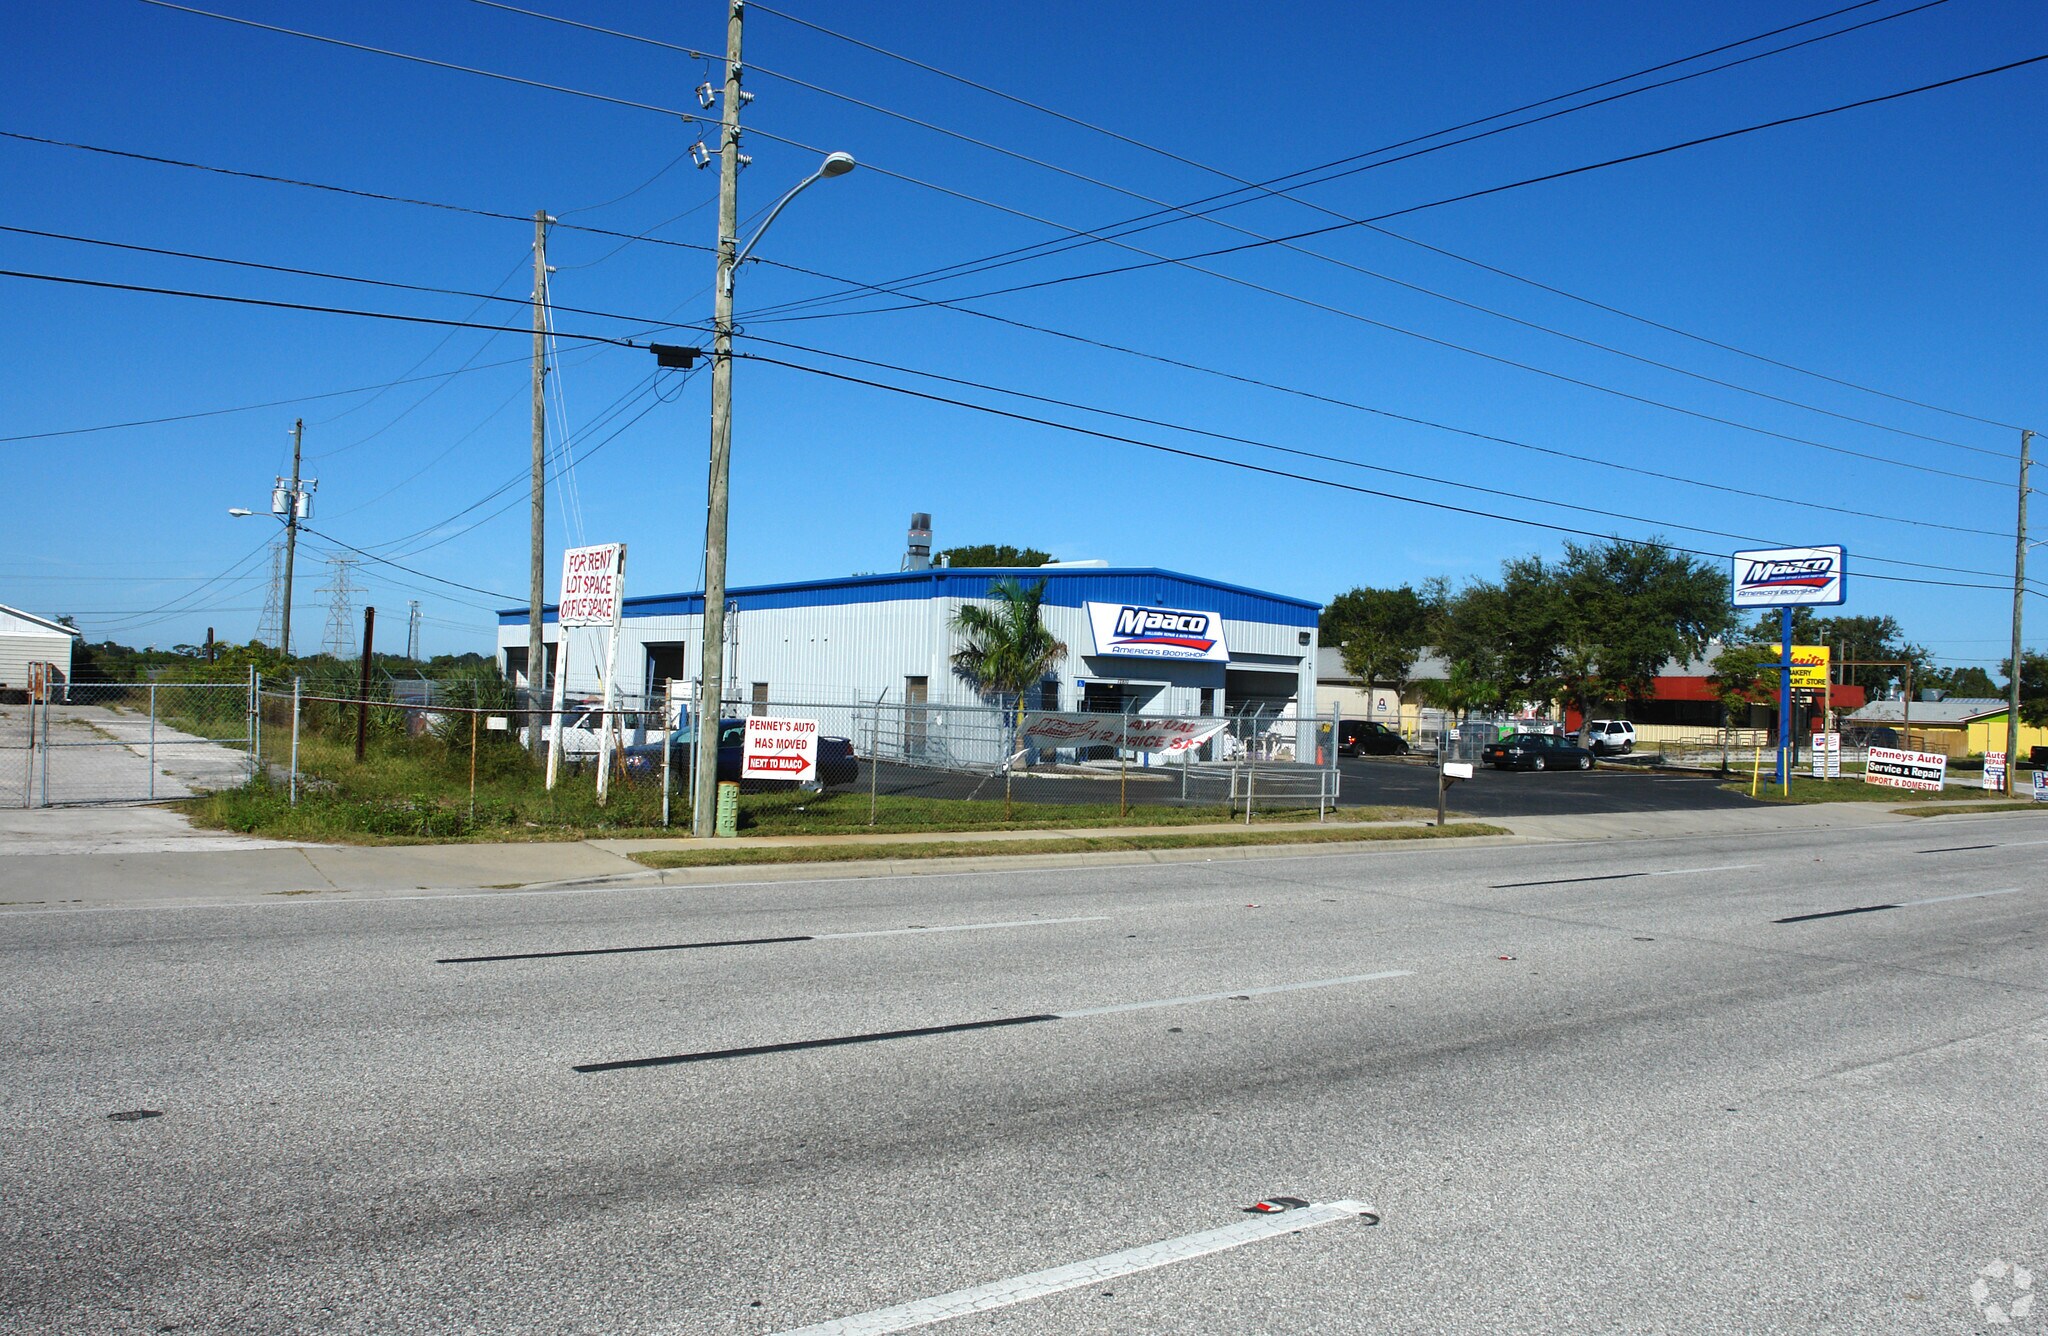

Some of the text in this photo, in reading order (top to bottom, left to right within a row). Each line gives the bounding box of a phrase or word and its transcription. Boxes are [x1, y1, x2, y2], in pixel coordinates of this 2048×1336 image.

[569, 550, 612, 573] FOR RENT
[566, 576, 612, 594] LOT SPACE
[561, 598, 612, 618] OFFICE SPACE
[1116, 608, 1208, 636] Maaco
[749, 720, 815, 732] PENNEY'S AUTO
[754, 738, 807, 749] HAS MOVED
[1869, 748, 1943, 764] Penneys Auto
[1985, 751, 2006, 759] Auto
[750, 758, 803, 769] NEXT TO MAACO
[1869, 762, 1940, 780] Service & Repair
[1866, 776, 1939, 791] IMPORT & DOMESTIC
